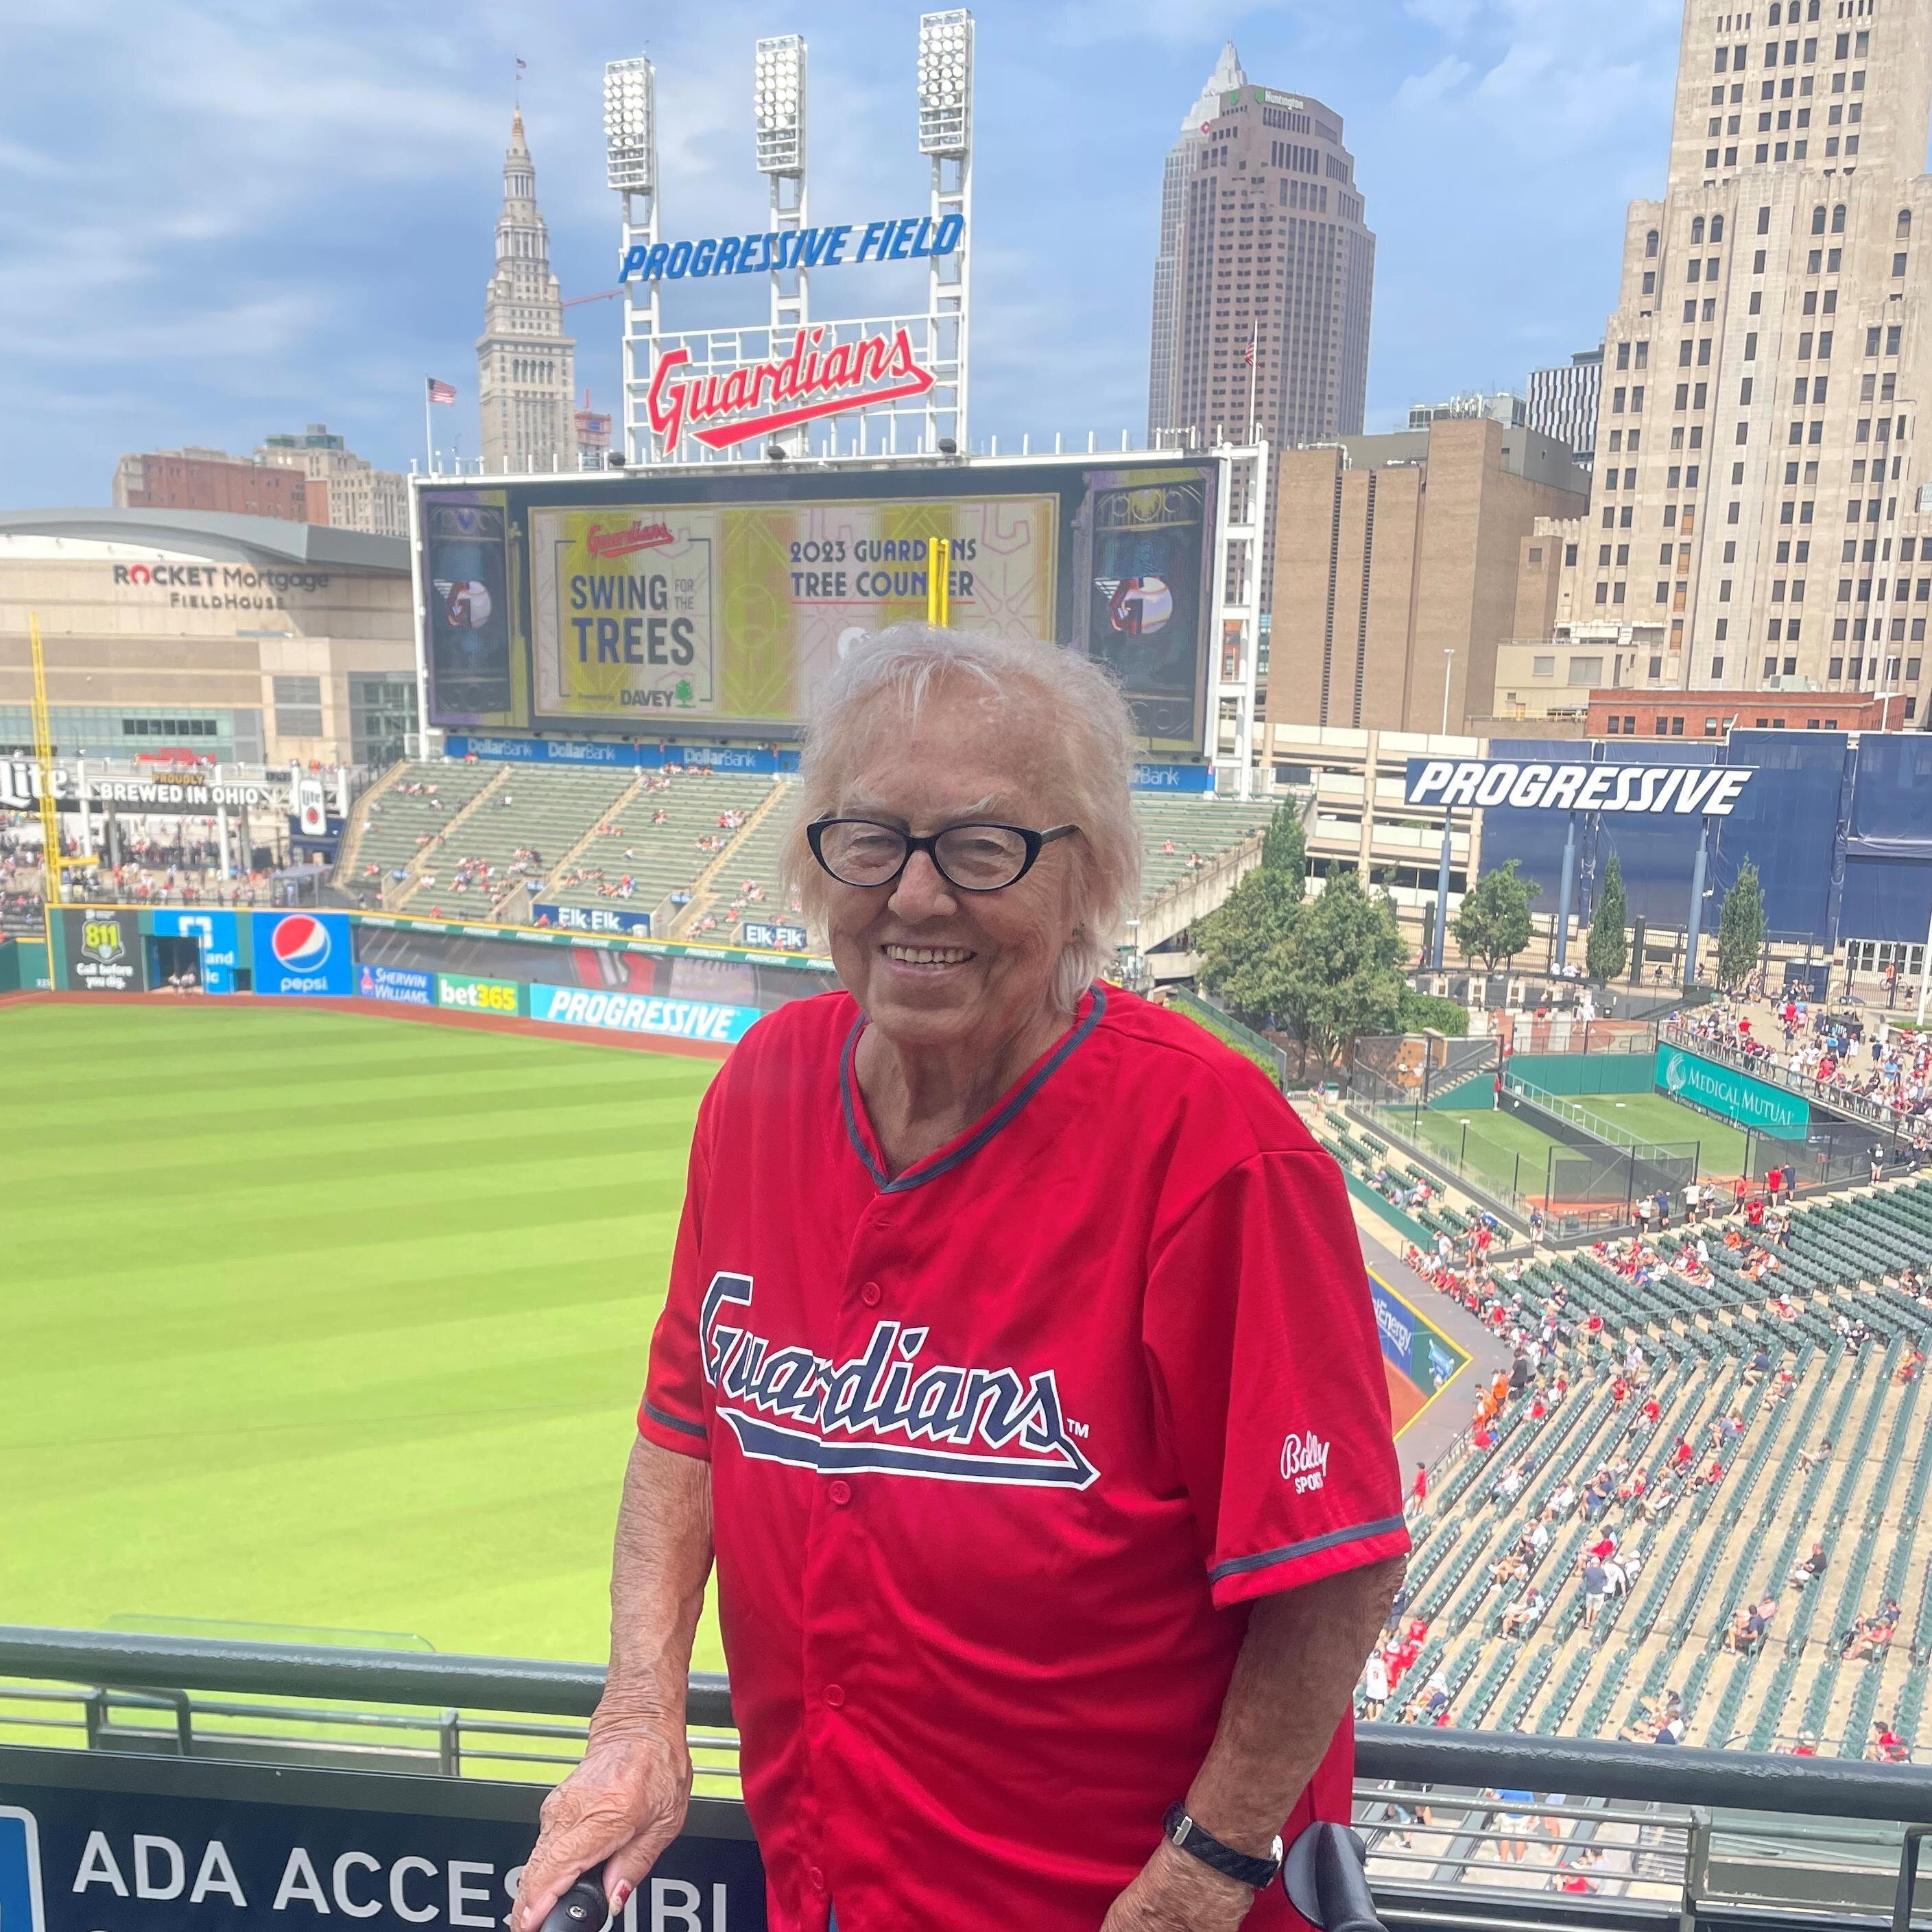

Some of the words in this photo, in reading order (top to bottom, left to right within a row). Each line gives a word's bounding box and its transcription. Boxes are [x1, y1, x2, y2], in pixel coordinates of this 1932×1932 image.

[618, 225, 852, 283] PROGRESSIVE
[855, 213, 964, 263] FIELD
[647, 325, 938, 457] Guardians
[789, 540, 846, 563] 2023
[854, 538, 977, 562] GUARDNS
[113, 564, 217, 586] ROCKET
[223, 567, 331, 592] Mortgage
[674, 578, 694, 593] FOR
[791, 571, 846, 597] TREE
[856, 571, 974, 597] COUNER
[571, 573, 668, 611] SWING
[675, 596, 695, 610] THE
[571, 617, 695, 667] TREES
[620, 689, 674, 707] DAVEY
[152, 773, 205, 785] PROUDLY
[1408, 761, 1753, 815] PROGRESSIVE
[101, 784, 183, 803] BREWED
[187, 785, 208, 804] IN
[212, 787, 259, 805] OHIO
[559, 907, 588, 930] Elk
[591, 910, 620, 930] Elk
[86, 923, 118, 948] 811
[746, 925, 772, 944] Elk
[776, 928, 802, 946] Elk
[76, 963, 98, 976] Call
[99, 964, 133, 977] before
[375, 967, 427, 988] SHERWIN
[281, 977, 328, 992] pepsi
[440, 979, 516, 1010] bet365
[548, 991, 737, 1039] PROGRESSIVE
[1688, 1066, 1740, 1105] MEDICAL
[1374, 1298, 1413, 1352] tEnergy
[698, 1271, 1101, 1491] Guardians
[1066, 1418, 1090, 1439] TM
[1280, 1430, 1331, 1479] Bally
[72, 1830, 248, 1907] ADA
[272, 1847, 728, 1932] ACCEIBL
